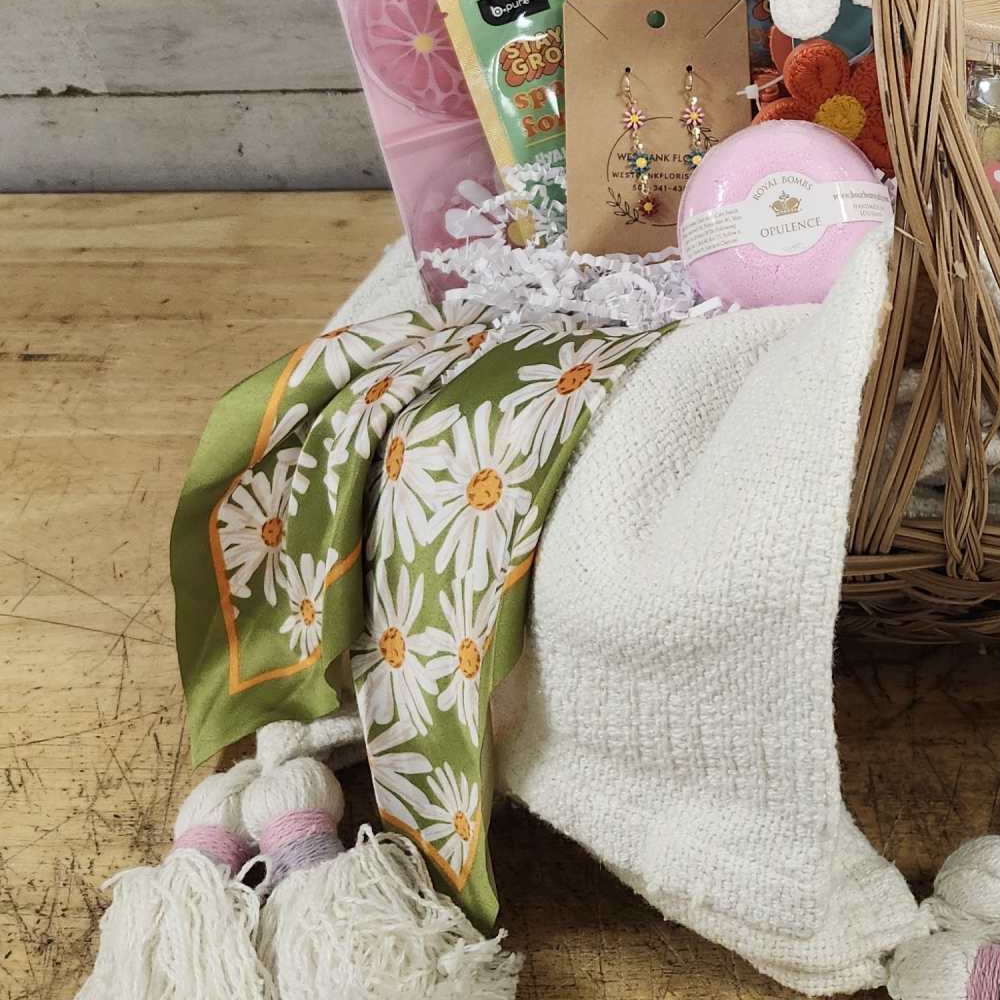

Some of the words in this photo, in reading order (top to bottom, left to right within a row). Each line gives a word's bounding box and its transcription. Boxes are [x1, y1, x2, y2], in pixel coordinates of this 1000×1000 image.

[503, 25, 563, 60] STAY
[511, 45, 563, 76] GRO
[752, 178, 777, 201] ROYAL
[781, 175, 814, 191] BOMBS
[760, 216, 823, 238] OPULENCE
